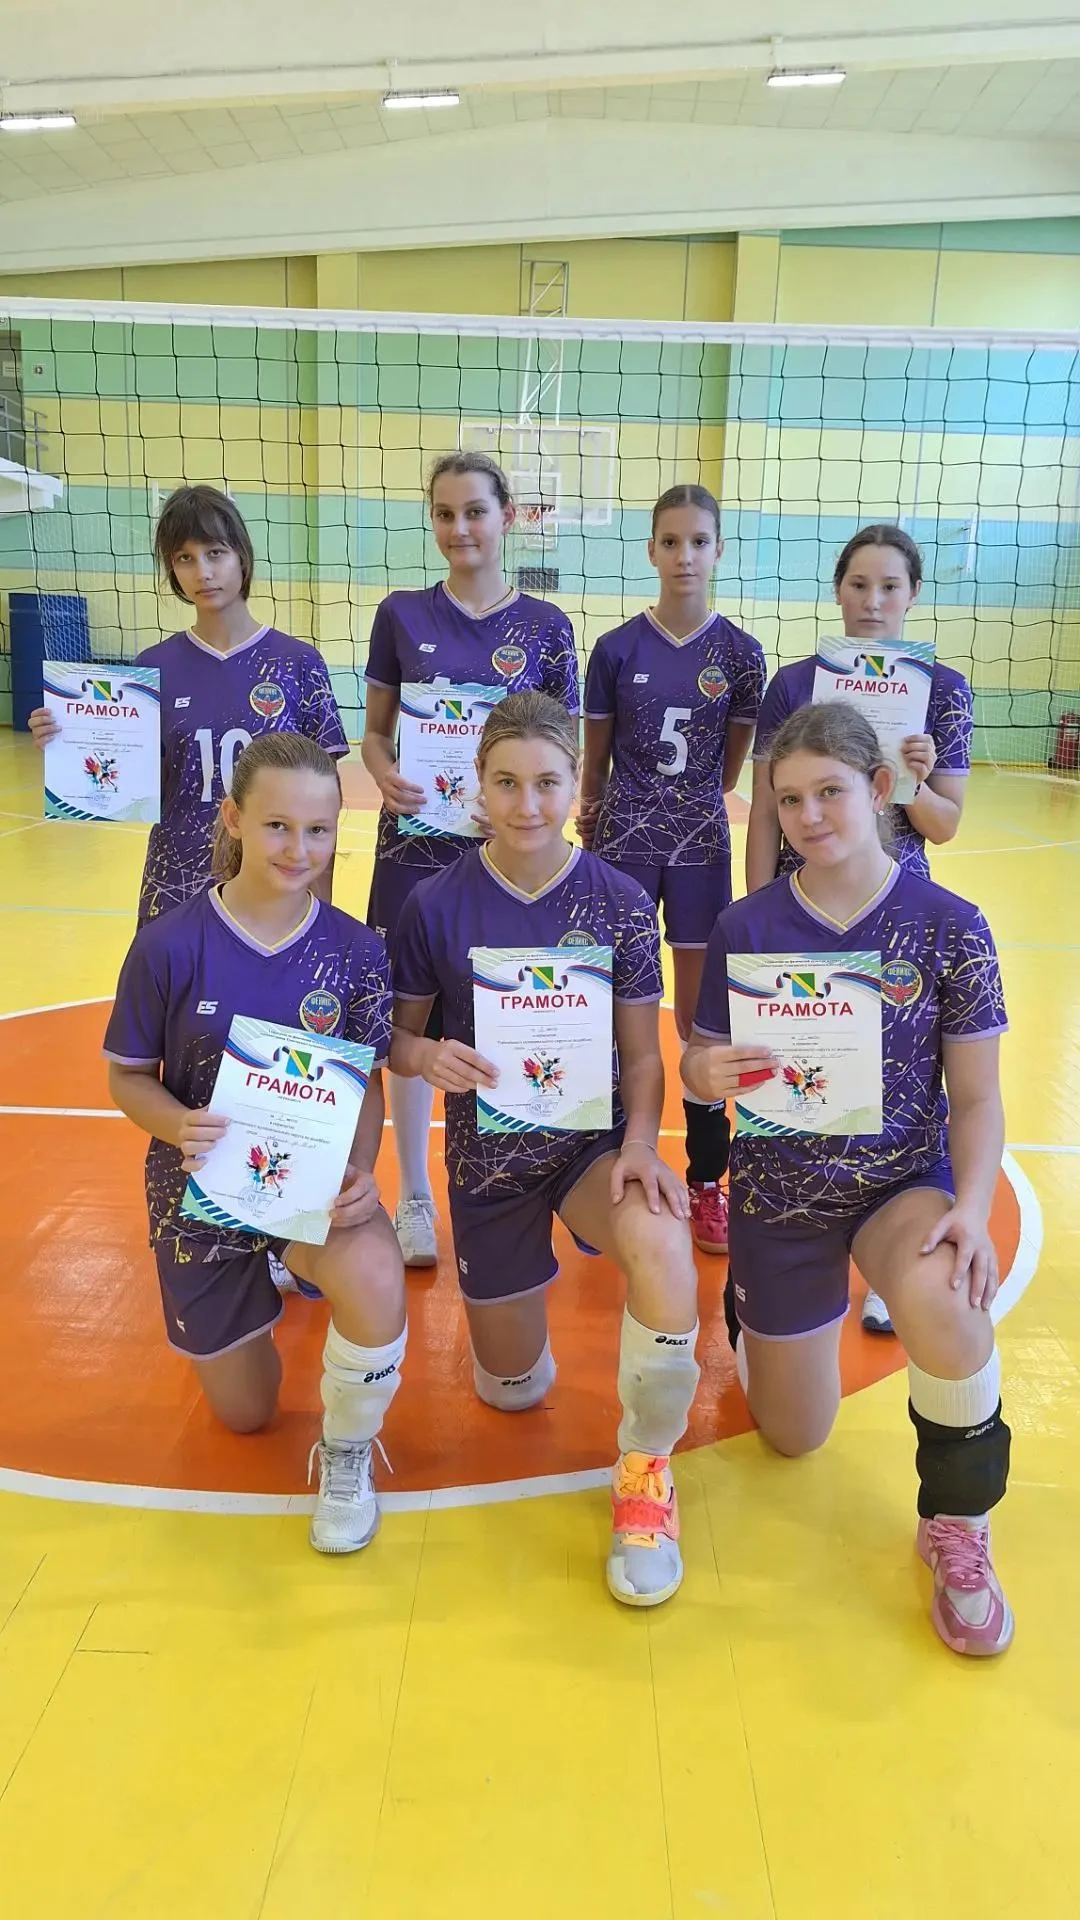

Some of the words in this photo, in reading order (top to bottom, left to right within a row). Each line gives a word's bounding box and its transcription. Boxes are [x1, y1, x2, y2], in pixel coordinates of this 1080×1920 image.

[836, 678, 908, 695] ГРАМОТА
[66, 703, 139, 718] ГРАМОТА
[656, 707, 692, 776] 5
[196, 1001, 218, 1014] ES
[501, 994, 588, 1009] ГРАМОТА
[757, 1002, 854, 1017] ГРАМОТА
[246, 1072, 337, 1106] ГРАМОТА
